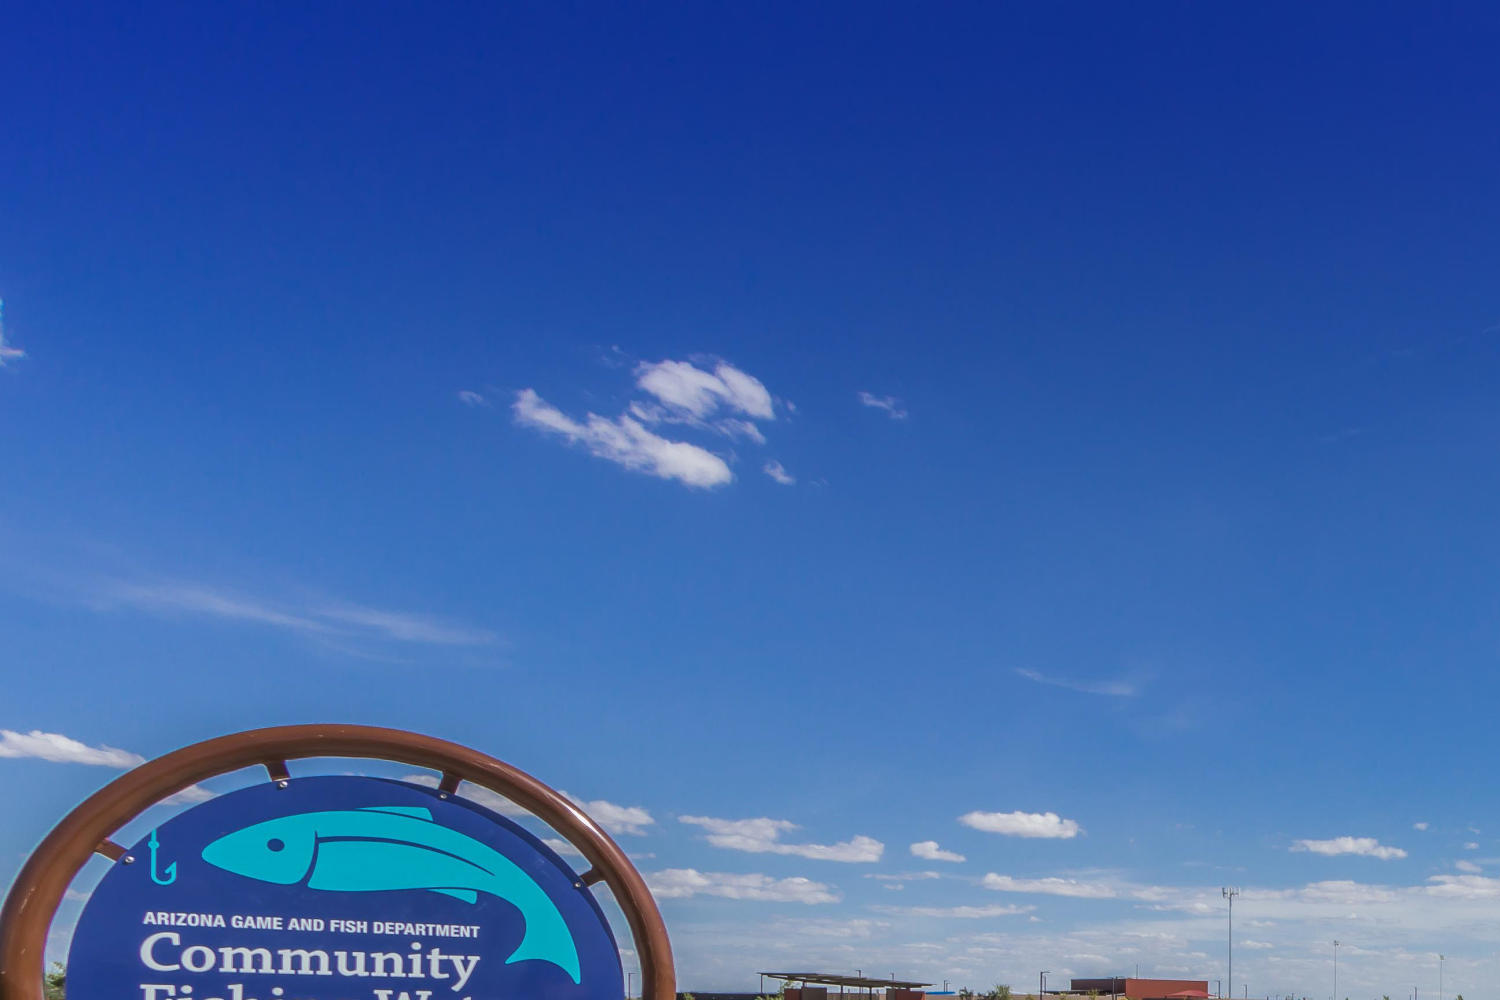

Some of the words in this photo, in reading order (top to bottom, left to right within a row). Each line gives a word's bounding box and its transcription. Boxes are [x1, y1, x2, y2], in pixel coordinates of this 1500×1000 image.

[143, 912, 226, 928] ARIZONA
[231, 915, 283, 930] GAME
[287, 917, 325, 932] AND
[330, 919, 368, 934] FISH
[373, 921, 481, 938] DEPARTMENT
[139, 931, 481, 992] Community
